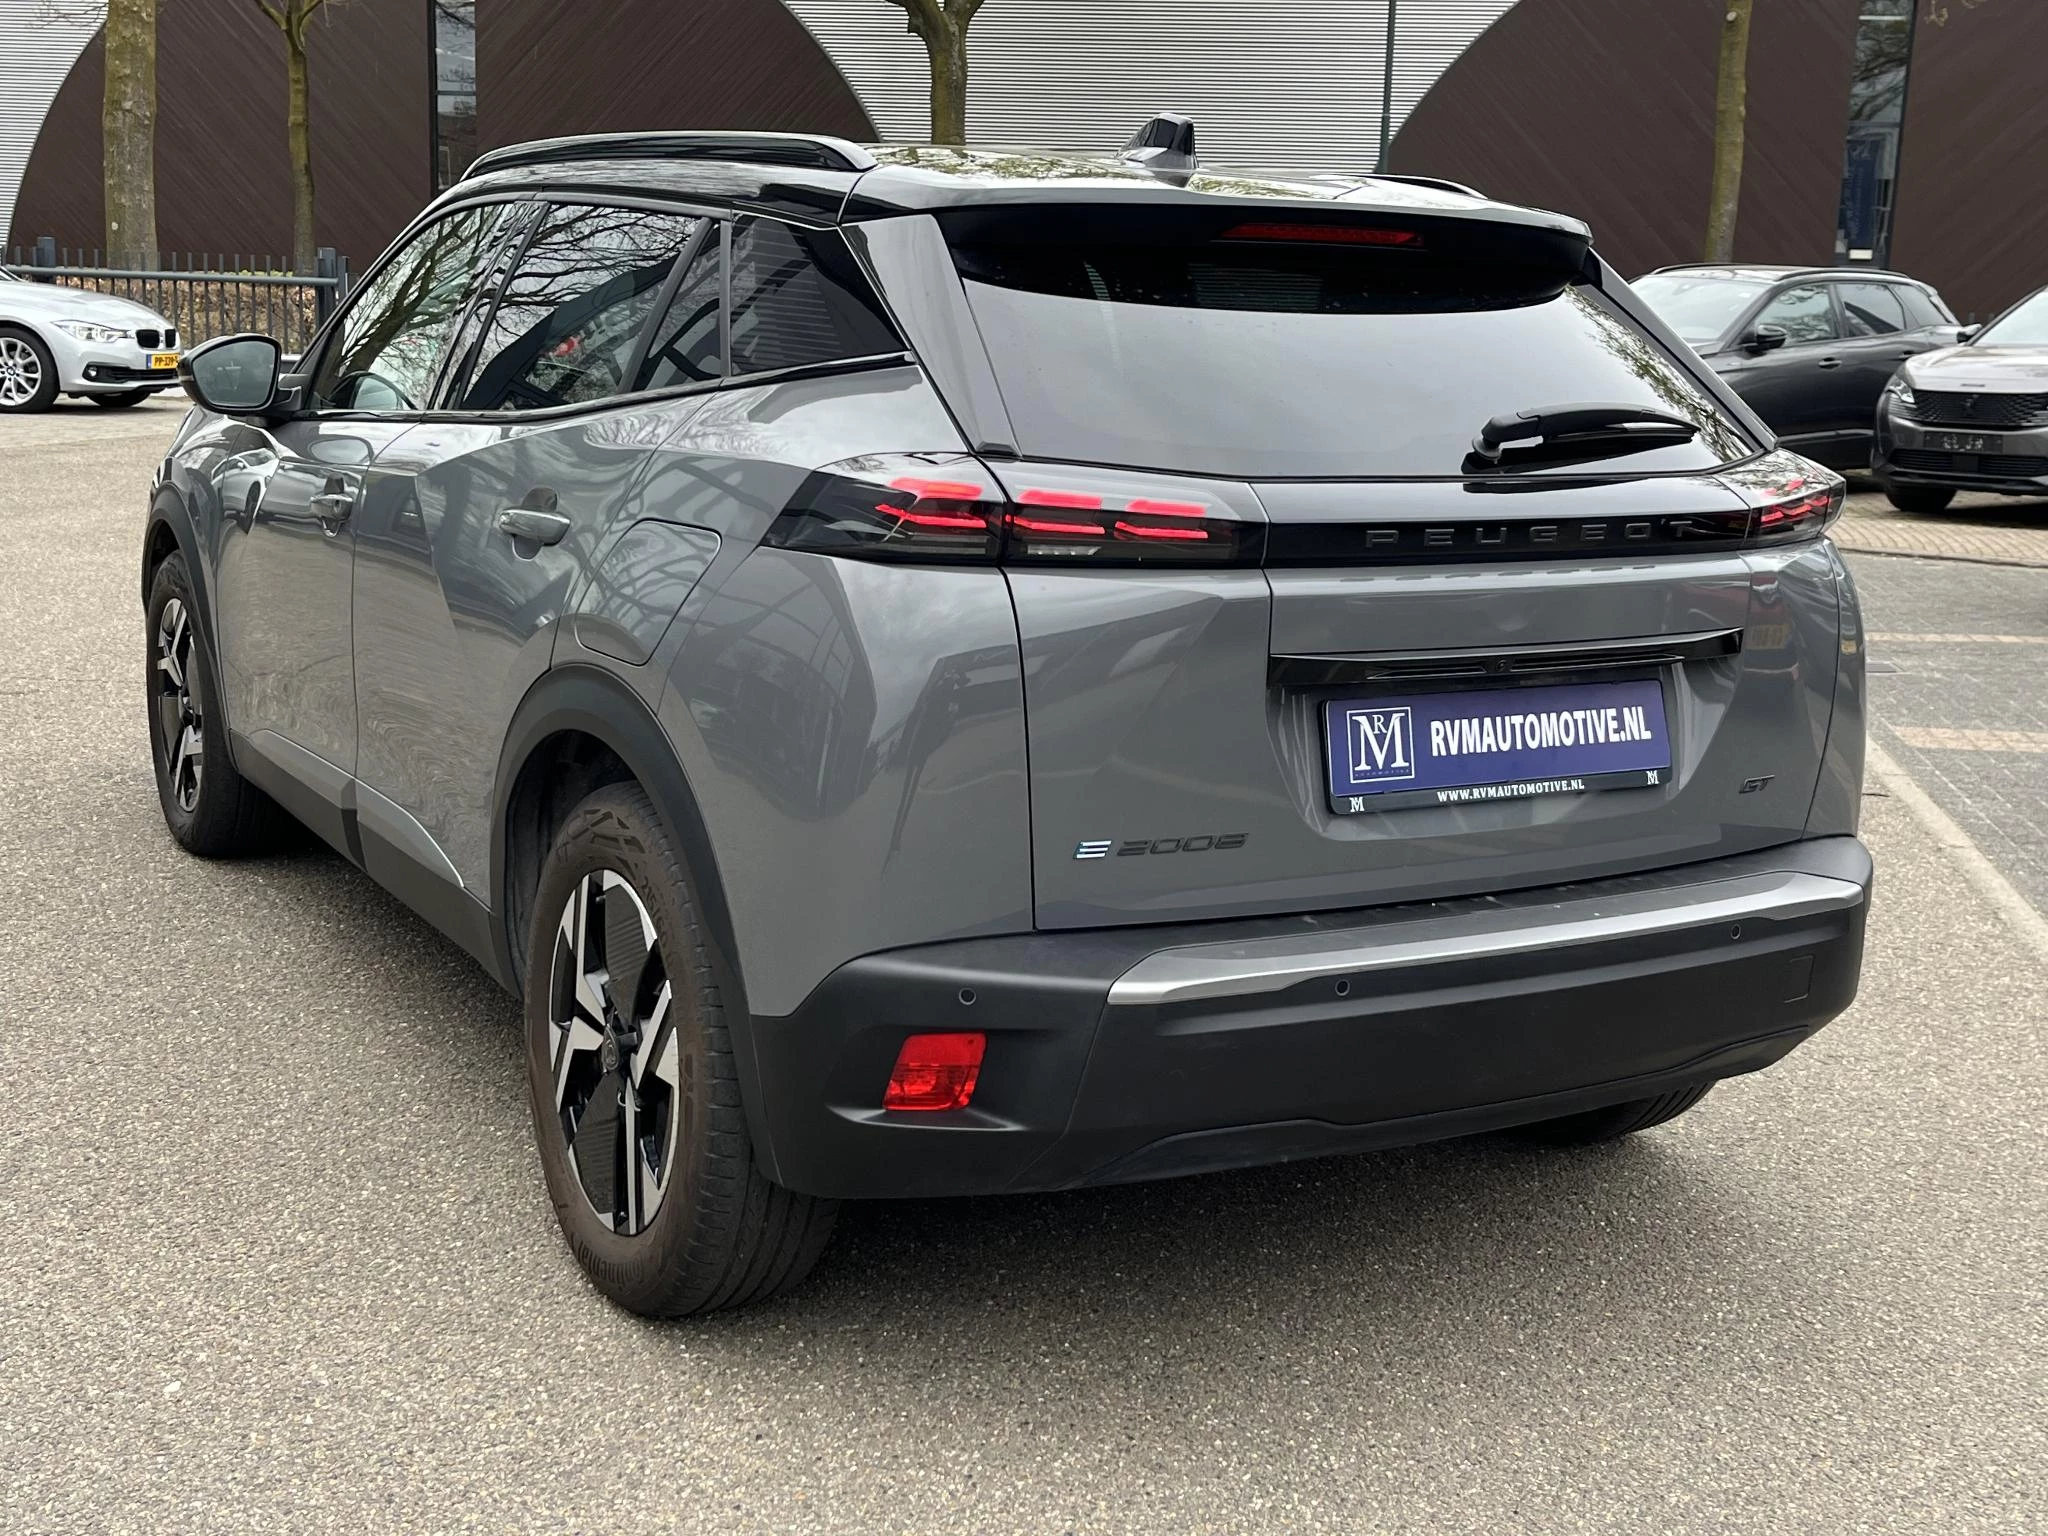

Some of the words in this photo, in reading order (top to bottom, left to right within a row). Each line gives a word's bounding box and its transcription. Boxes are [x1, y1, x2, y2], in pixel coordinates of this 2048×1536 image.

[1365, 519, 1693, 548] PEUGEOT
[1430, 706, 1652, 757] RVMAUTOMOTIVE.NL
[1436, 779, 1585, 802] WWW.RVMAUTOMOTIVE.NL
[1739, 774, 1775, 794] GT
